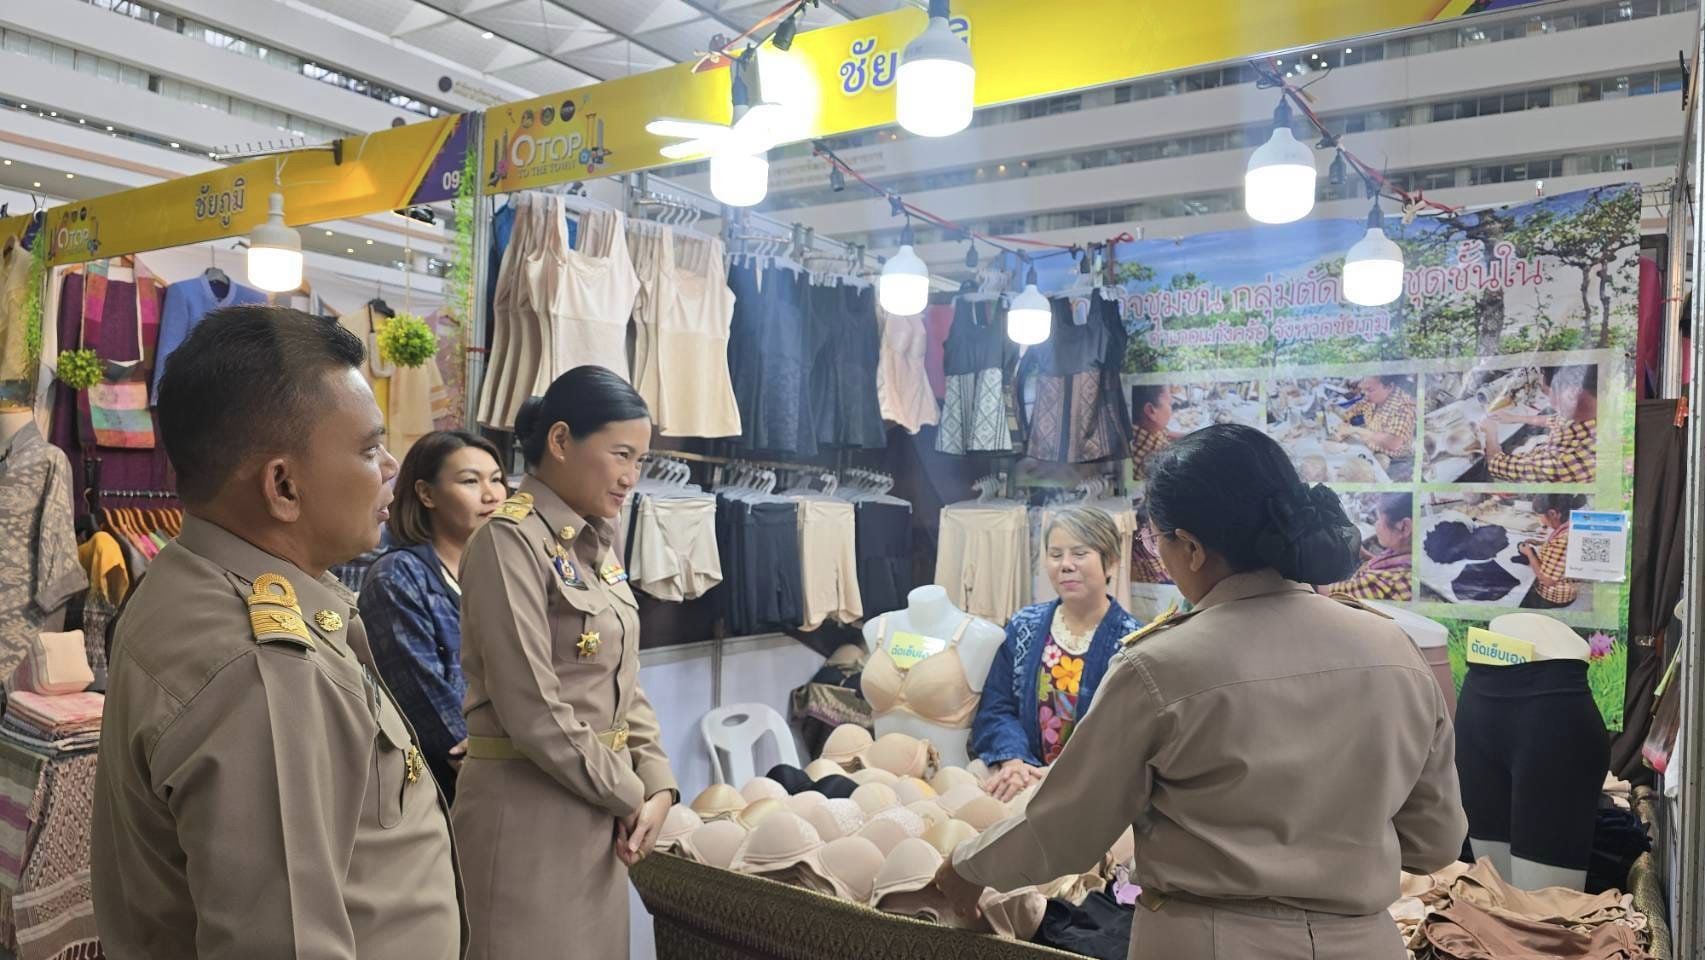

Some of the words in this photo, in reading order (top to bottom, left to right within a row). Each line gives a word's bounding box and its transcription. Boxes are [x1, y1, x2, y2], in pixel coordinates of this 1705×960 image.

[511, 133, 583, 168] OTOP
[195, 177, 246, 226] ชัยภูมิ
